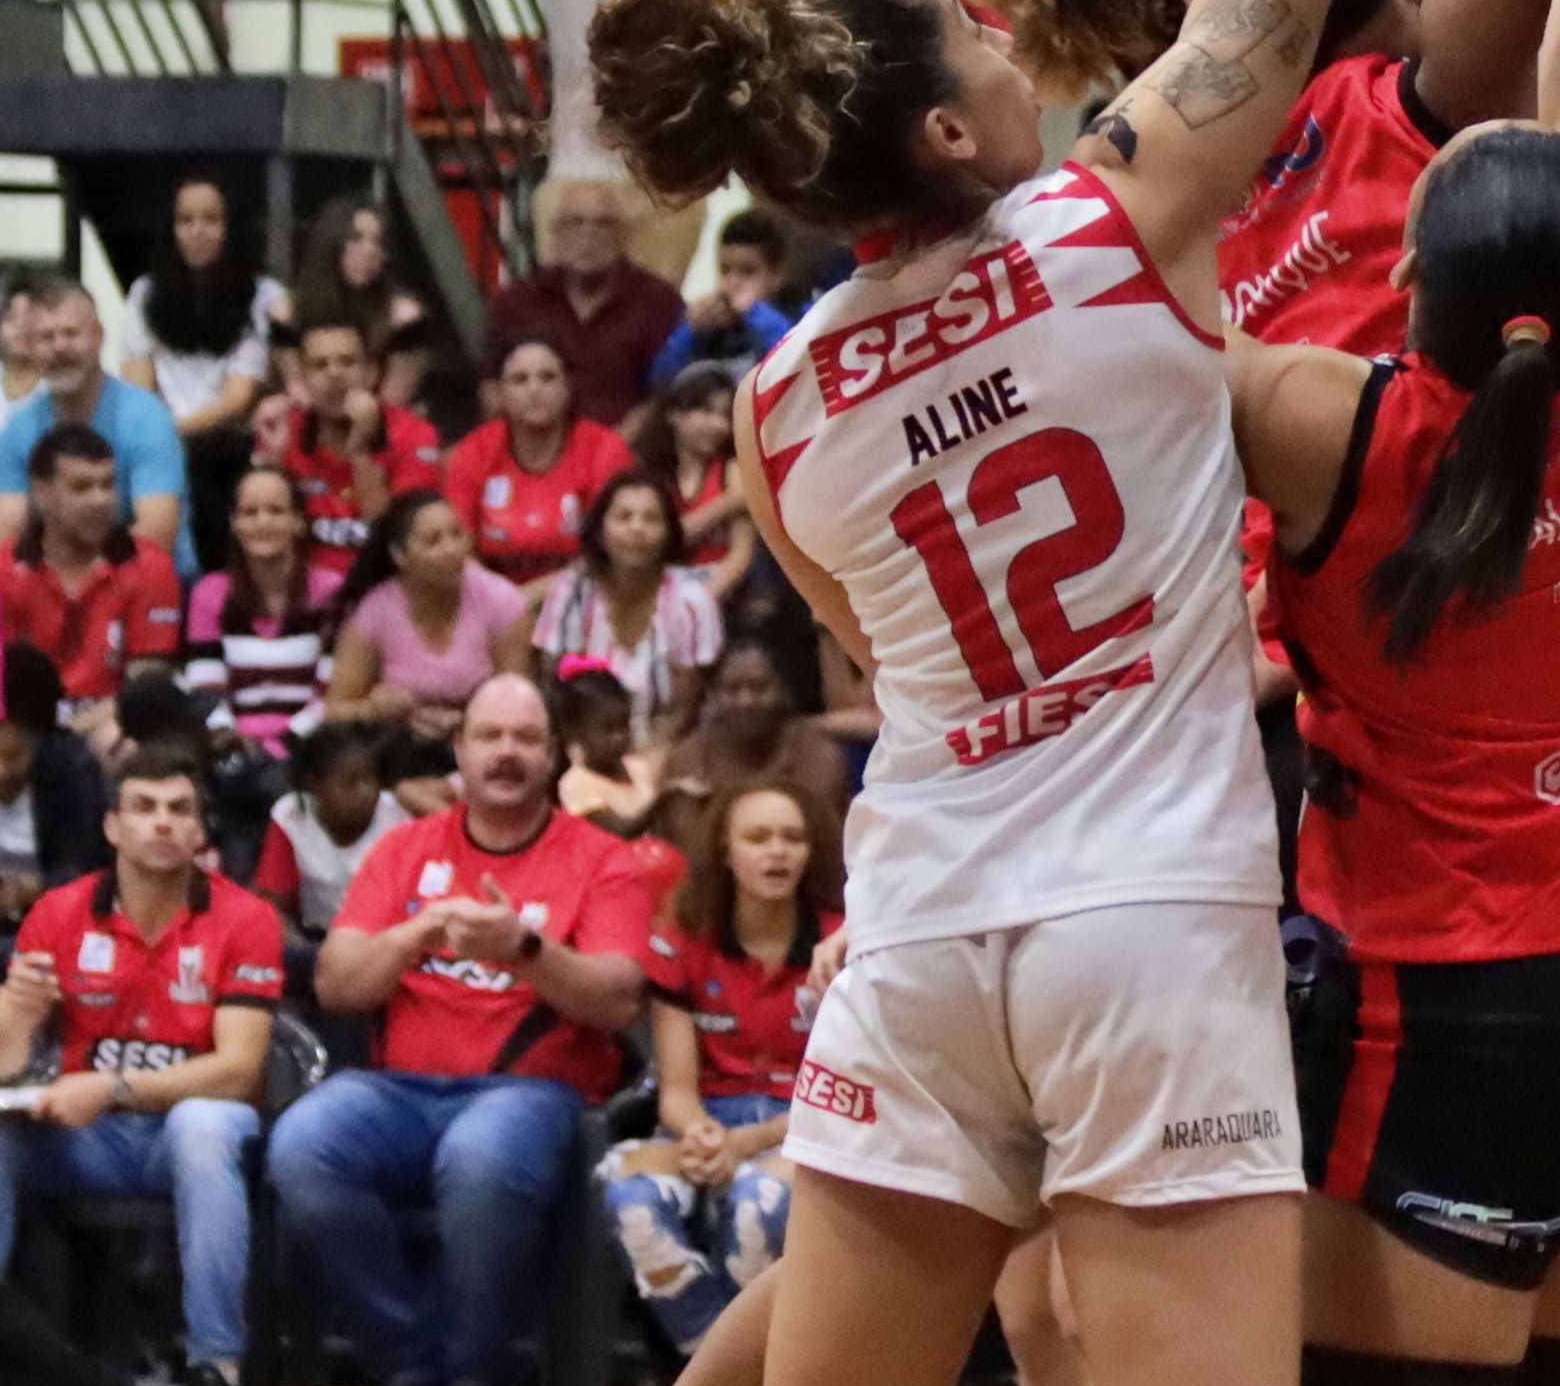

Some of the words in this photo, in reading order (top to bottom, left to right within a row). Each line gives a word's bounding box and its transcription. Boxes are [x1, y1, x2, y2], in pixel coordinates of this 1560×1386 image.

[839, 257, 1018, 400] SESI
[901, 366, 1028, 466] ALINE
[889, 425, 1155, 704] 12
[796, 1065, 868, 1121] SESI
[1162, 1109, 1283, 1151] ARARAQUARA
